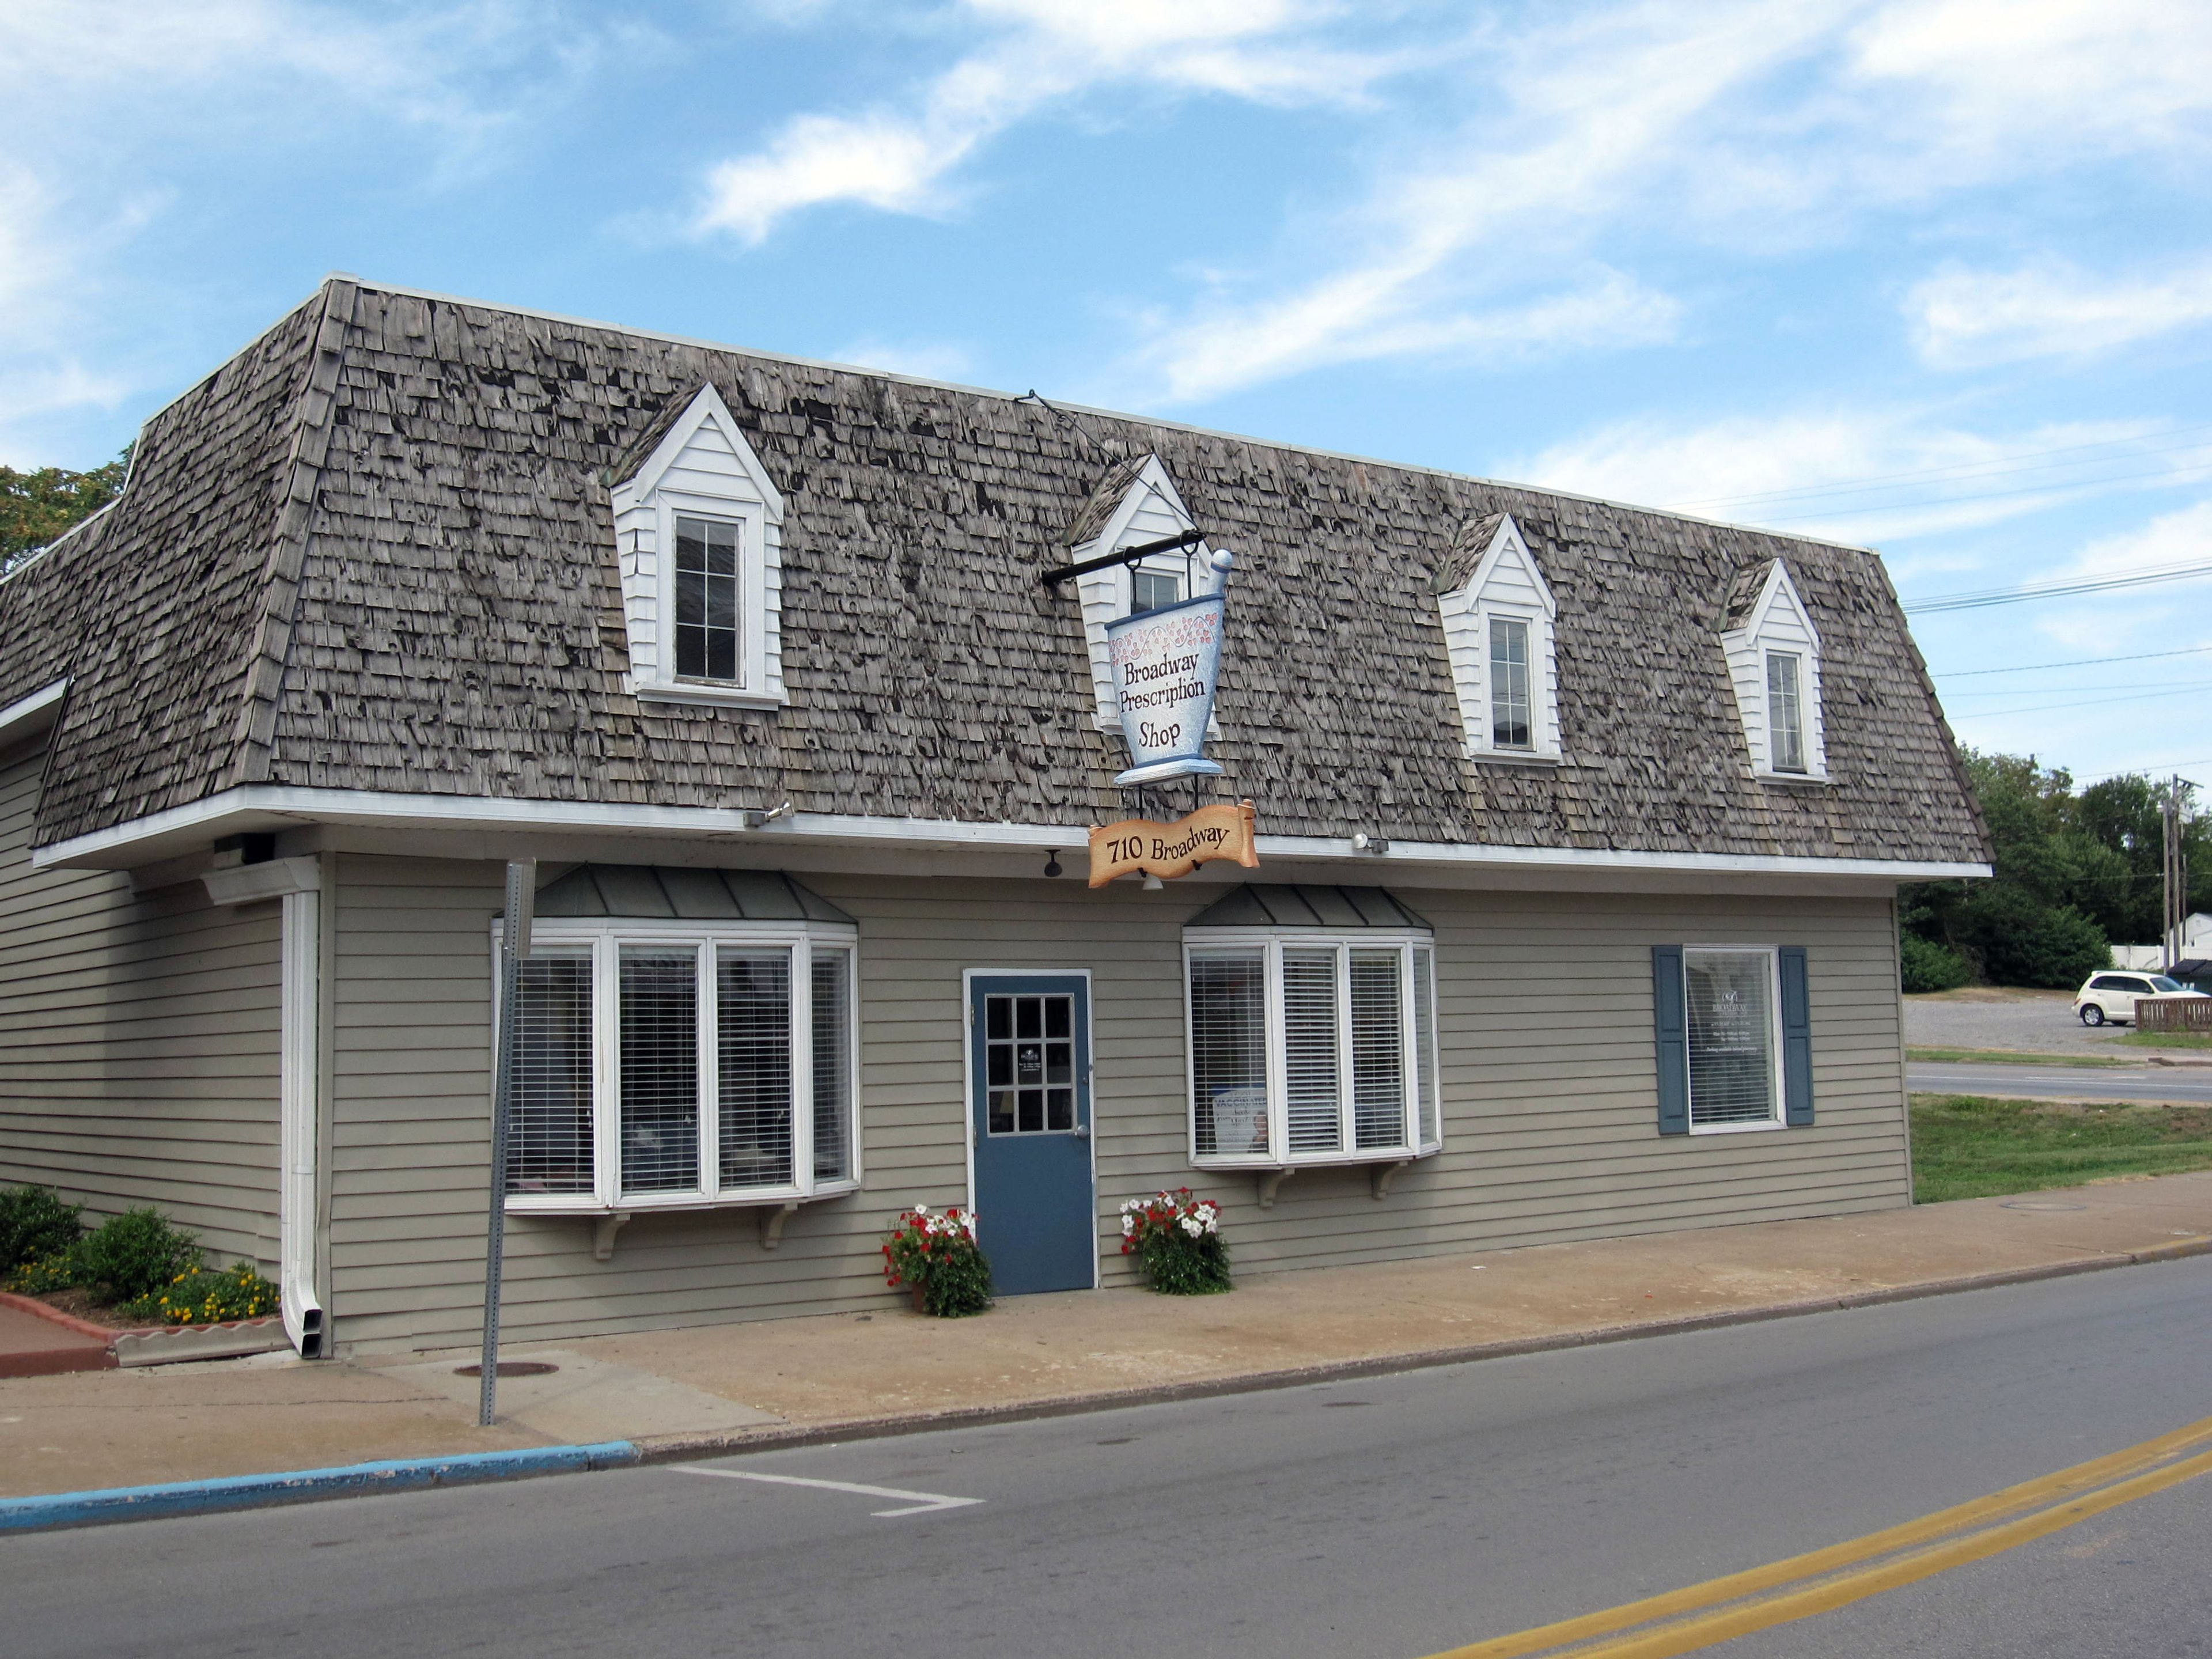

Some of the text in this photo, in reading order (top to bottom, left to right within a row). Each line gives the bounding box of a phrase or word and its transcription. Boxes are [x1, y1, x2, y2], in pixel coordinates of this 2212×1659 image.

[1124, 653, 1199, 685] Broadway
[1120, 677, 1206, 713] Prescription
[1138, 722, 1180, 748] Shop
[1107, 825, 1230, 863] 710 Broadway
